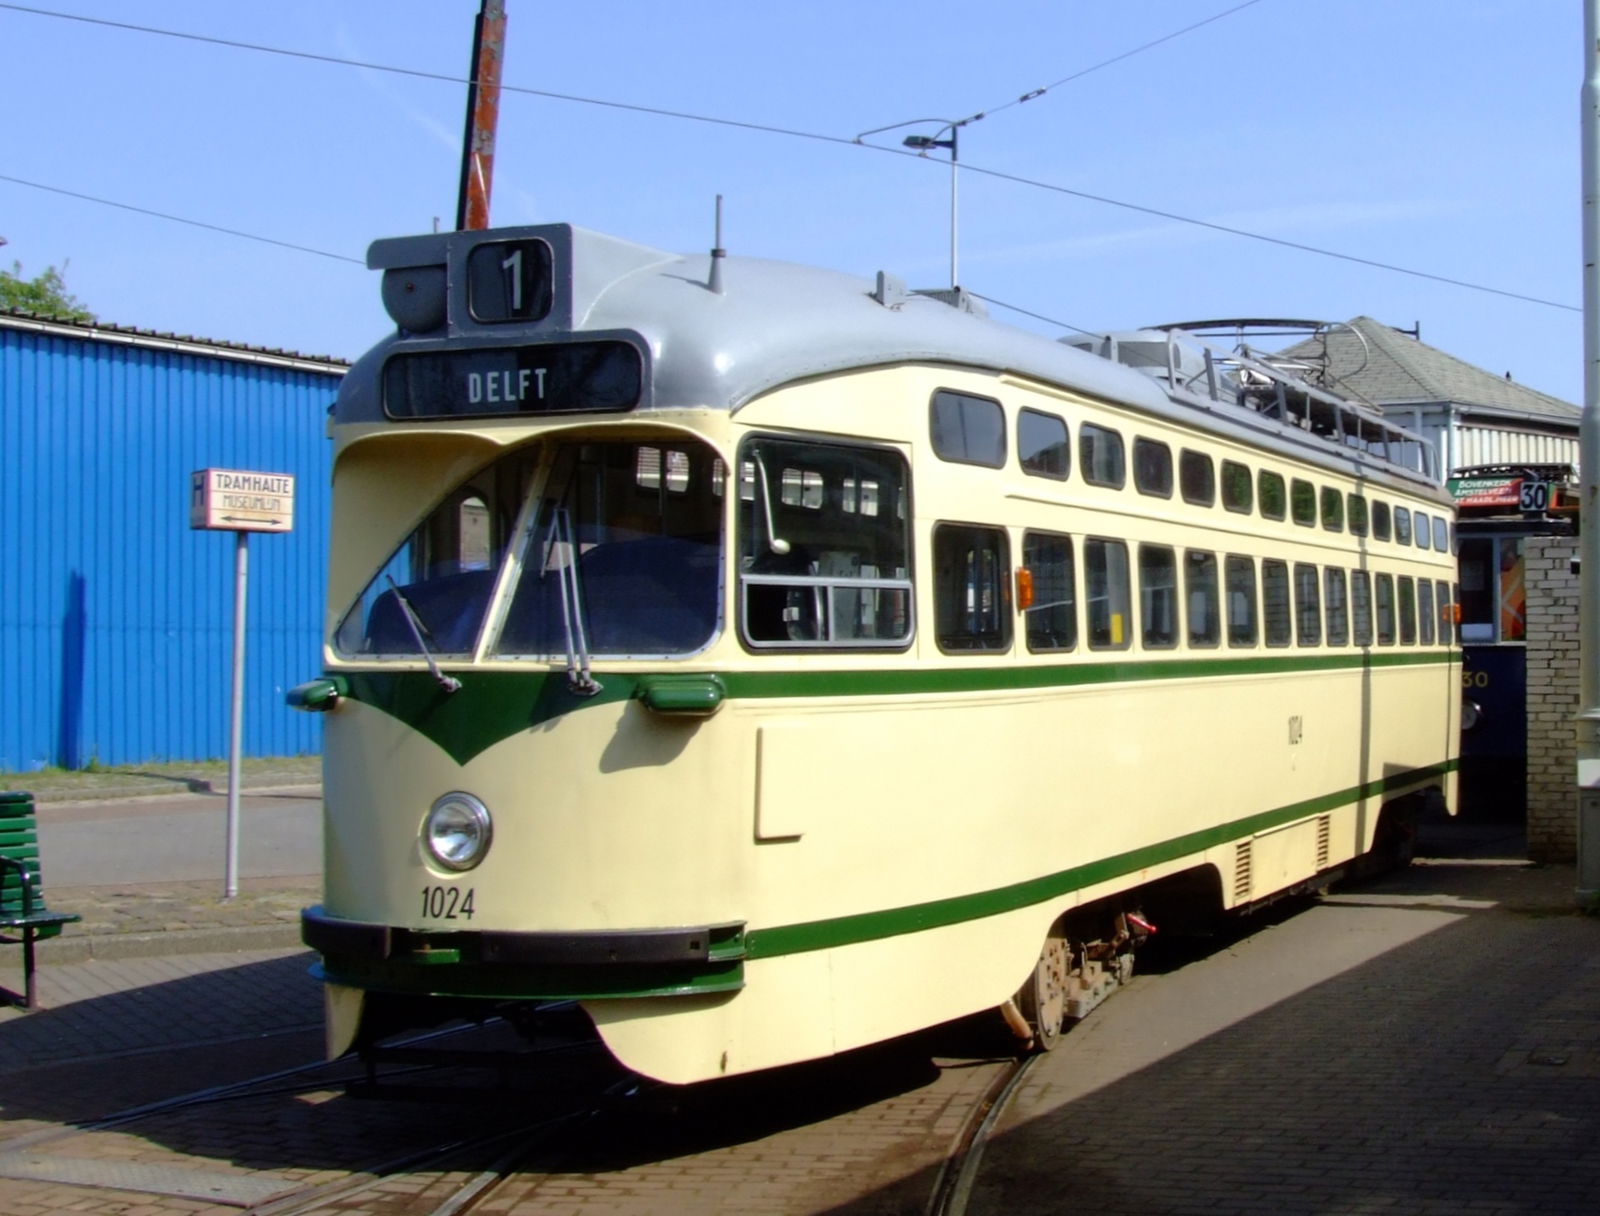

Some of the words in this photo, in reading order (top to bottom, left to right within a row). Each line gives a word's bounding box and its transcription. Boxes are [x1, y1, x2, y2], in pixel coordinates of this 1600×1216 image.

[502, 250, 522, 310] 1
[468, 368, 547, 404] DELFT
[216, 474, 290, 494] TRAMHALTE
[1521, 484, 1546, 509] 30
[422, 886, 475, 920] 1024
